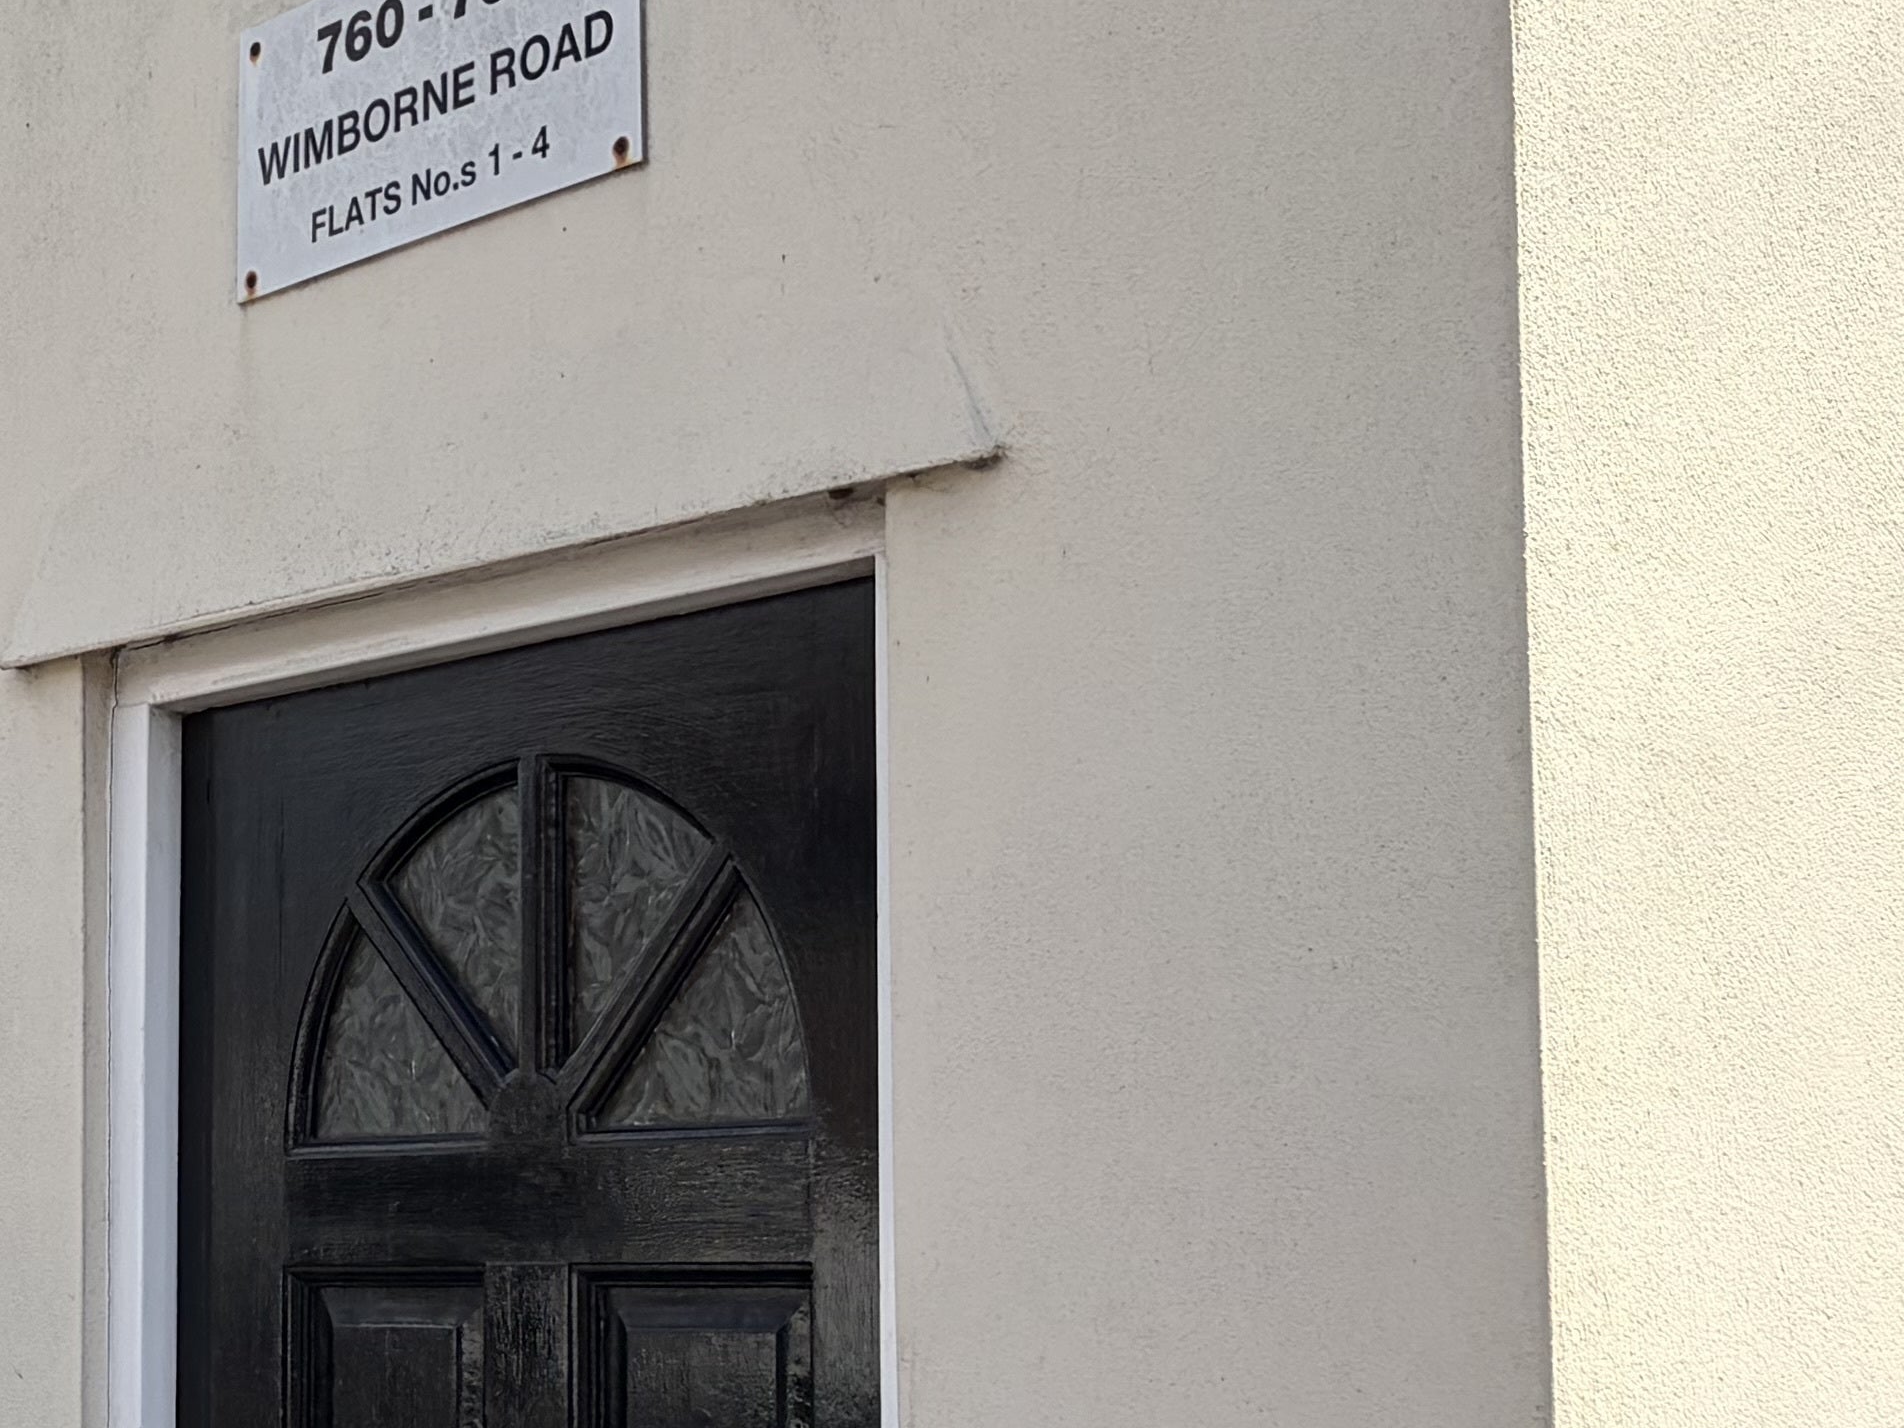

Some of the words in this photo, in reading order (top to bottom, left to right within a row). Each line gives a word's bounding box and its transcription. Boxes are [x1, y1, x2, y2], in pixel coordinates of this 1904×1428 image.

[418, 3, 434, 22] -
[257, 61, 476, 186] WIMBORNE
[489, 9, 614, 96] ROAD
[310, 181, 402, 243] FLATS
[410, 160, 476, 206] No.s
[488, 143, 501, 176] 1
[531, 125, 550, 159] 4
